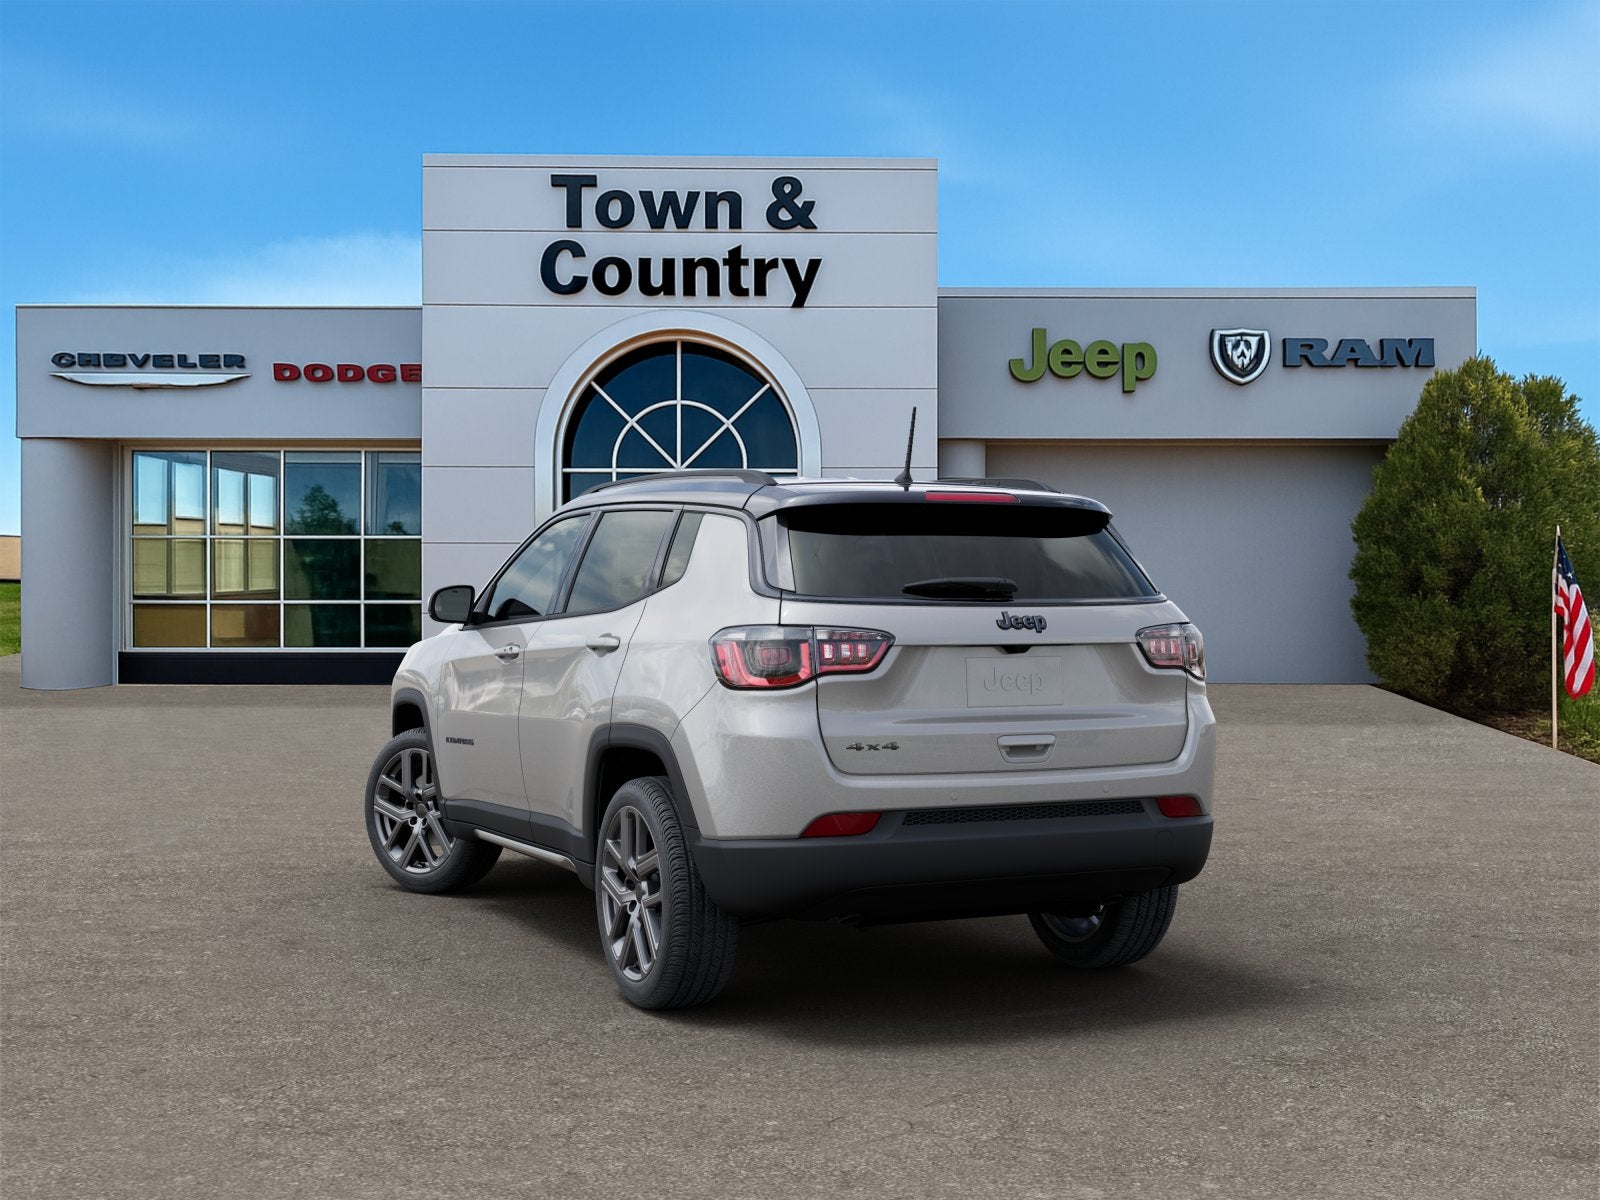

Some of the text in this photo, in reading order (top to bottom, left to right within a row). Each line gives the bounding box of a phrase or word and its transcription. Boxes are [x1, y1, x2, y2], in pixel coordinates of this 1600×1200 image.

[550, 174, 818, 230] Town &
[540, 240, 823, 308] Country
[1009, 328, 1157, 392] Jeep
[1282, 337, 1435, 368] RAM
[273, 362, 422, 383] DODGE
[996, 611, 1047, 633] Jeep
[983, 667, 1043, 695] Jeep
[846, 742, 900, 752] 4x4
